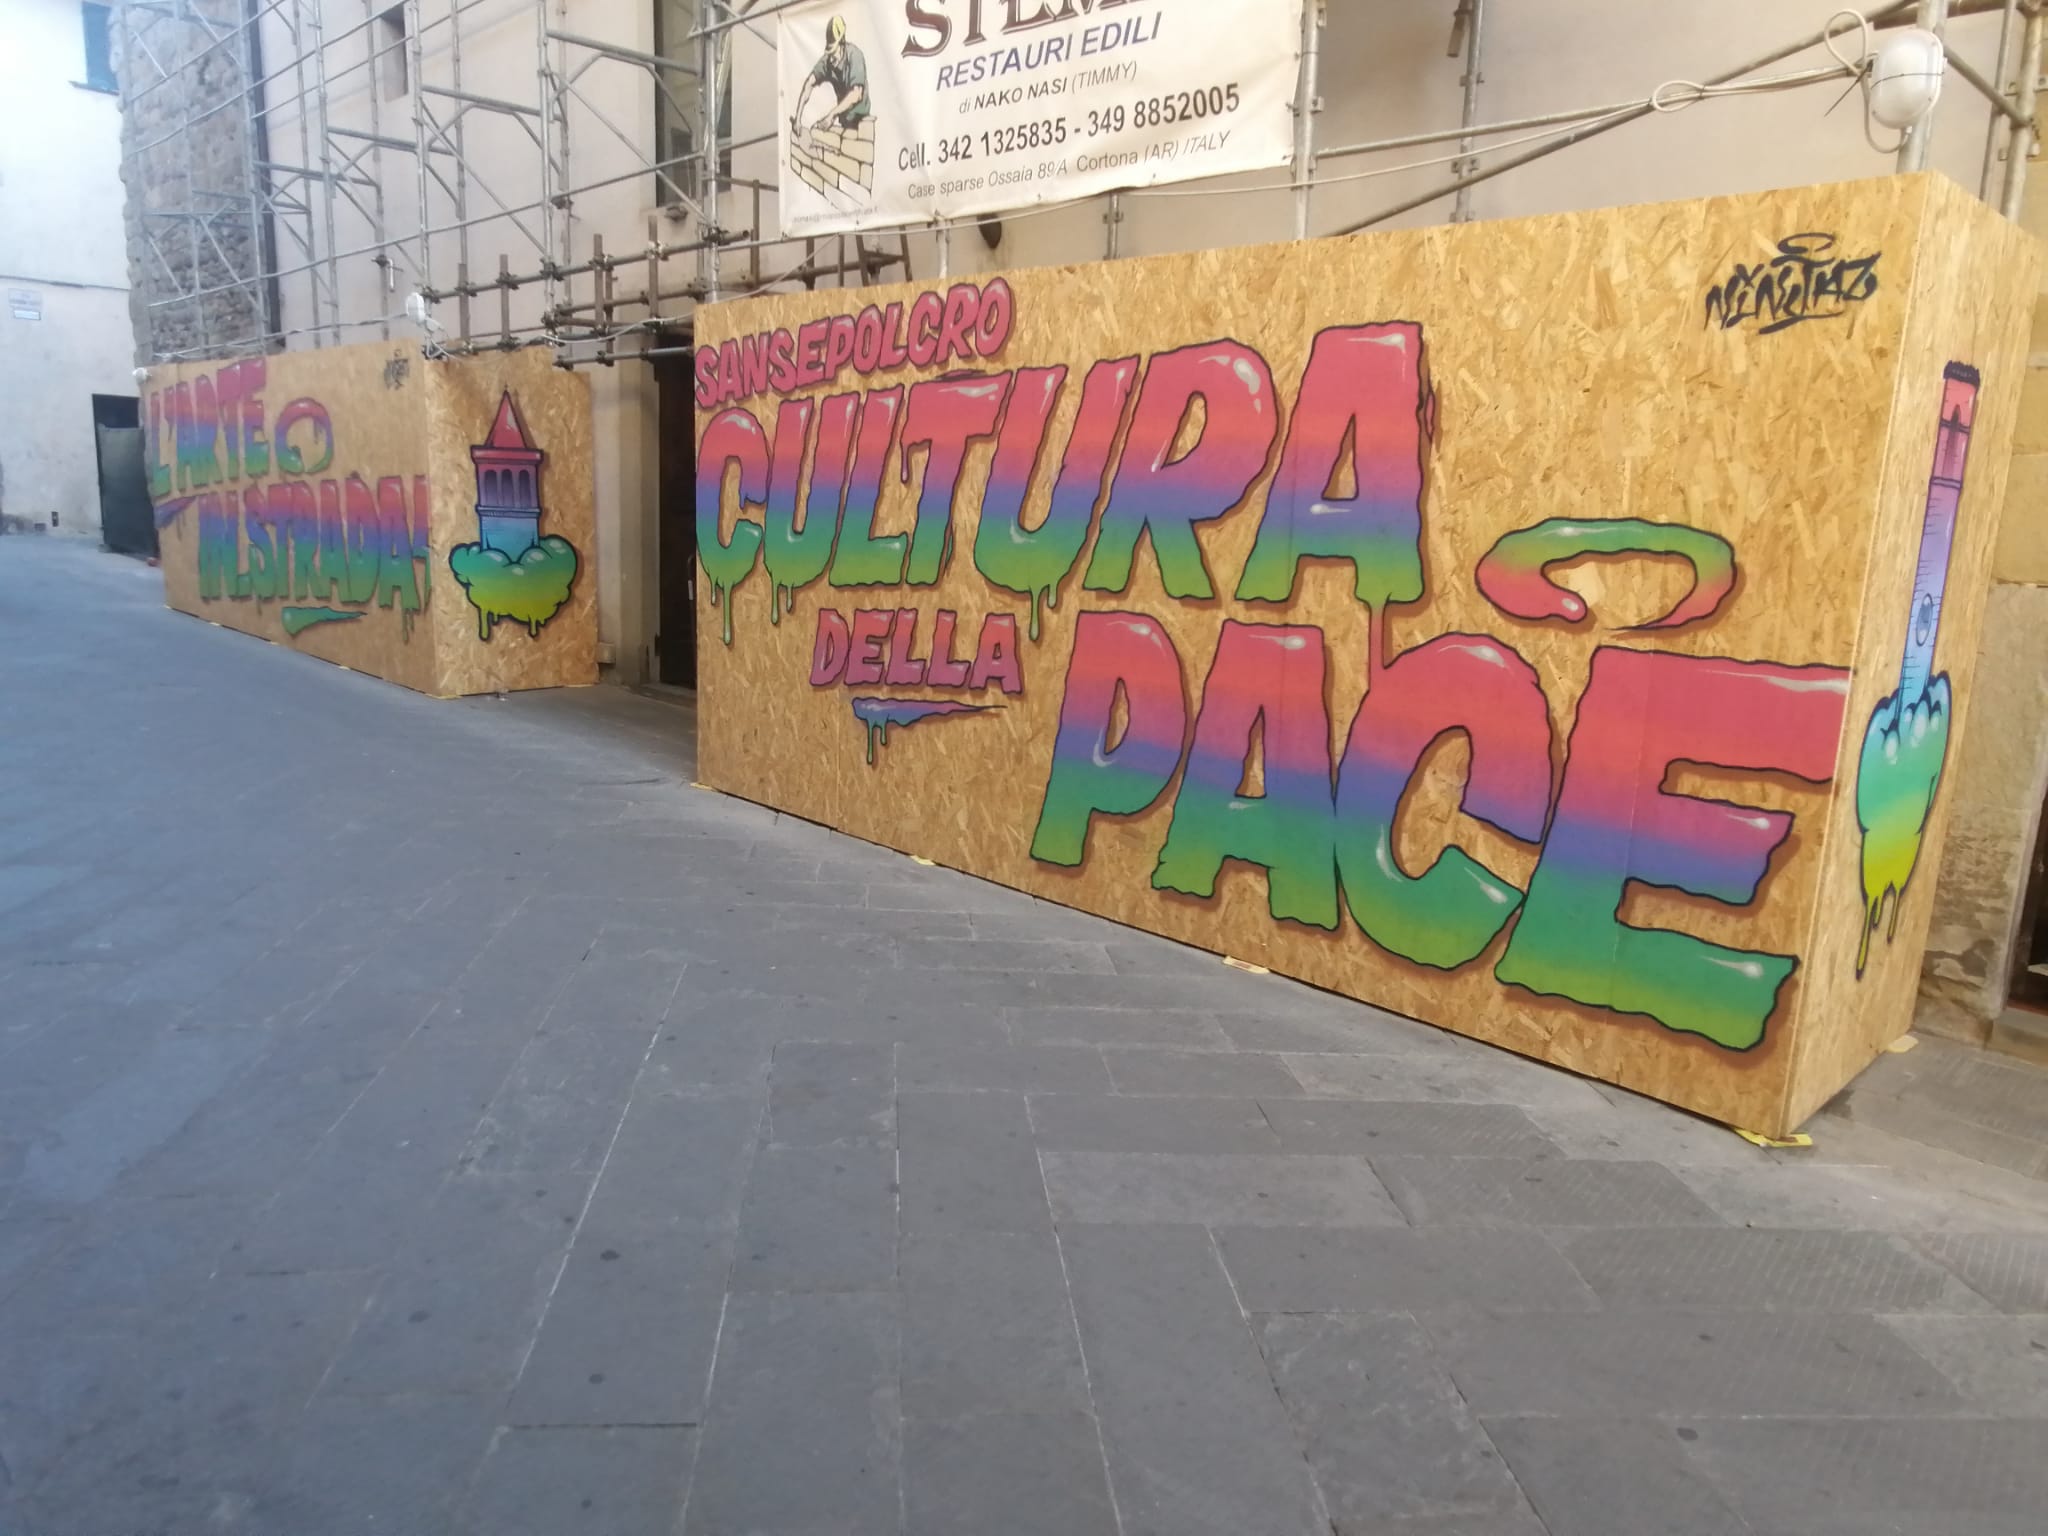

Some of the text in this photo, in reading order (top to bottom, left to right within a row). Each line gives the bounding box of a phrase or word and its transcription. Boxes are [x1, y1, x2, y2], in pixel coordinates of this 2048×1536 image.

[936, 11, 1162, 91] RESTAURI EDILI
[958, 61, 1137, 114] di NAKO NASI (TIMMY)
[898, 141, 931, 171] Cell.
[938, 134, 973, 164] 342
[980, 117, 1067, 157] 1325835
[1087, 108, 1125, 138] 349
[1133, 83, 1240, 129] 8852005
[908, 183, 936, 200] Case
[940, 177, 984, 196] sparse
[988, 165, 1033, 187] Ossaia
[1076, 151, 1139, 173] Cortona
[1144, 140, 1179, 164] (AR)
[1183, 130, 1231, 156] ITALY
[694, 277, 1012, 408] SANSEPOLCRO
[697, 321, 1425, 606] CULTURA
[811, 608, 1024, 694] DELLA
[1030, 610, 1853, 1052] PACE
